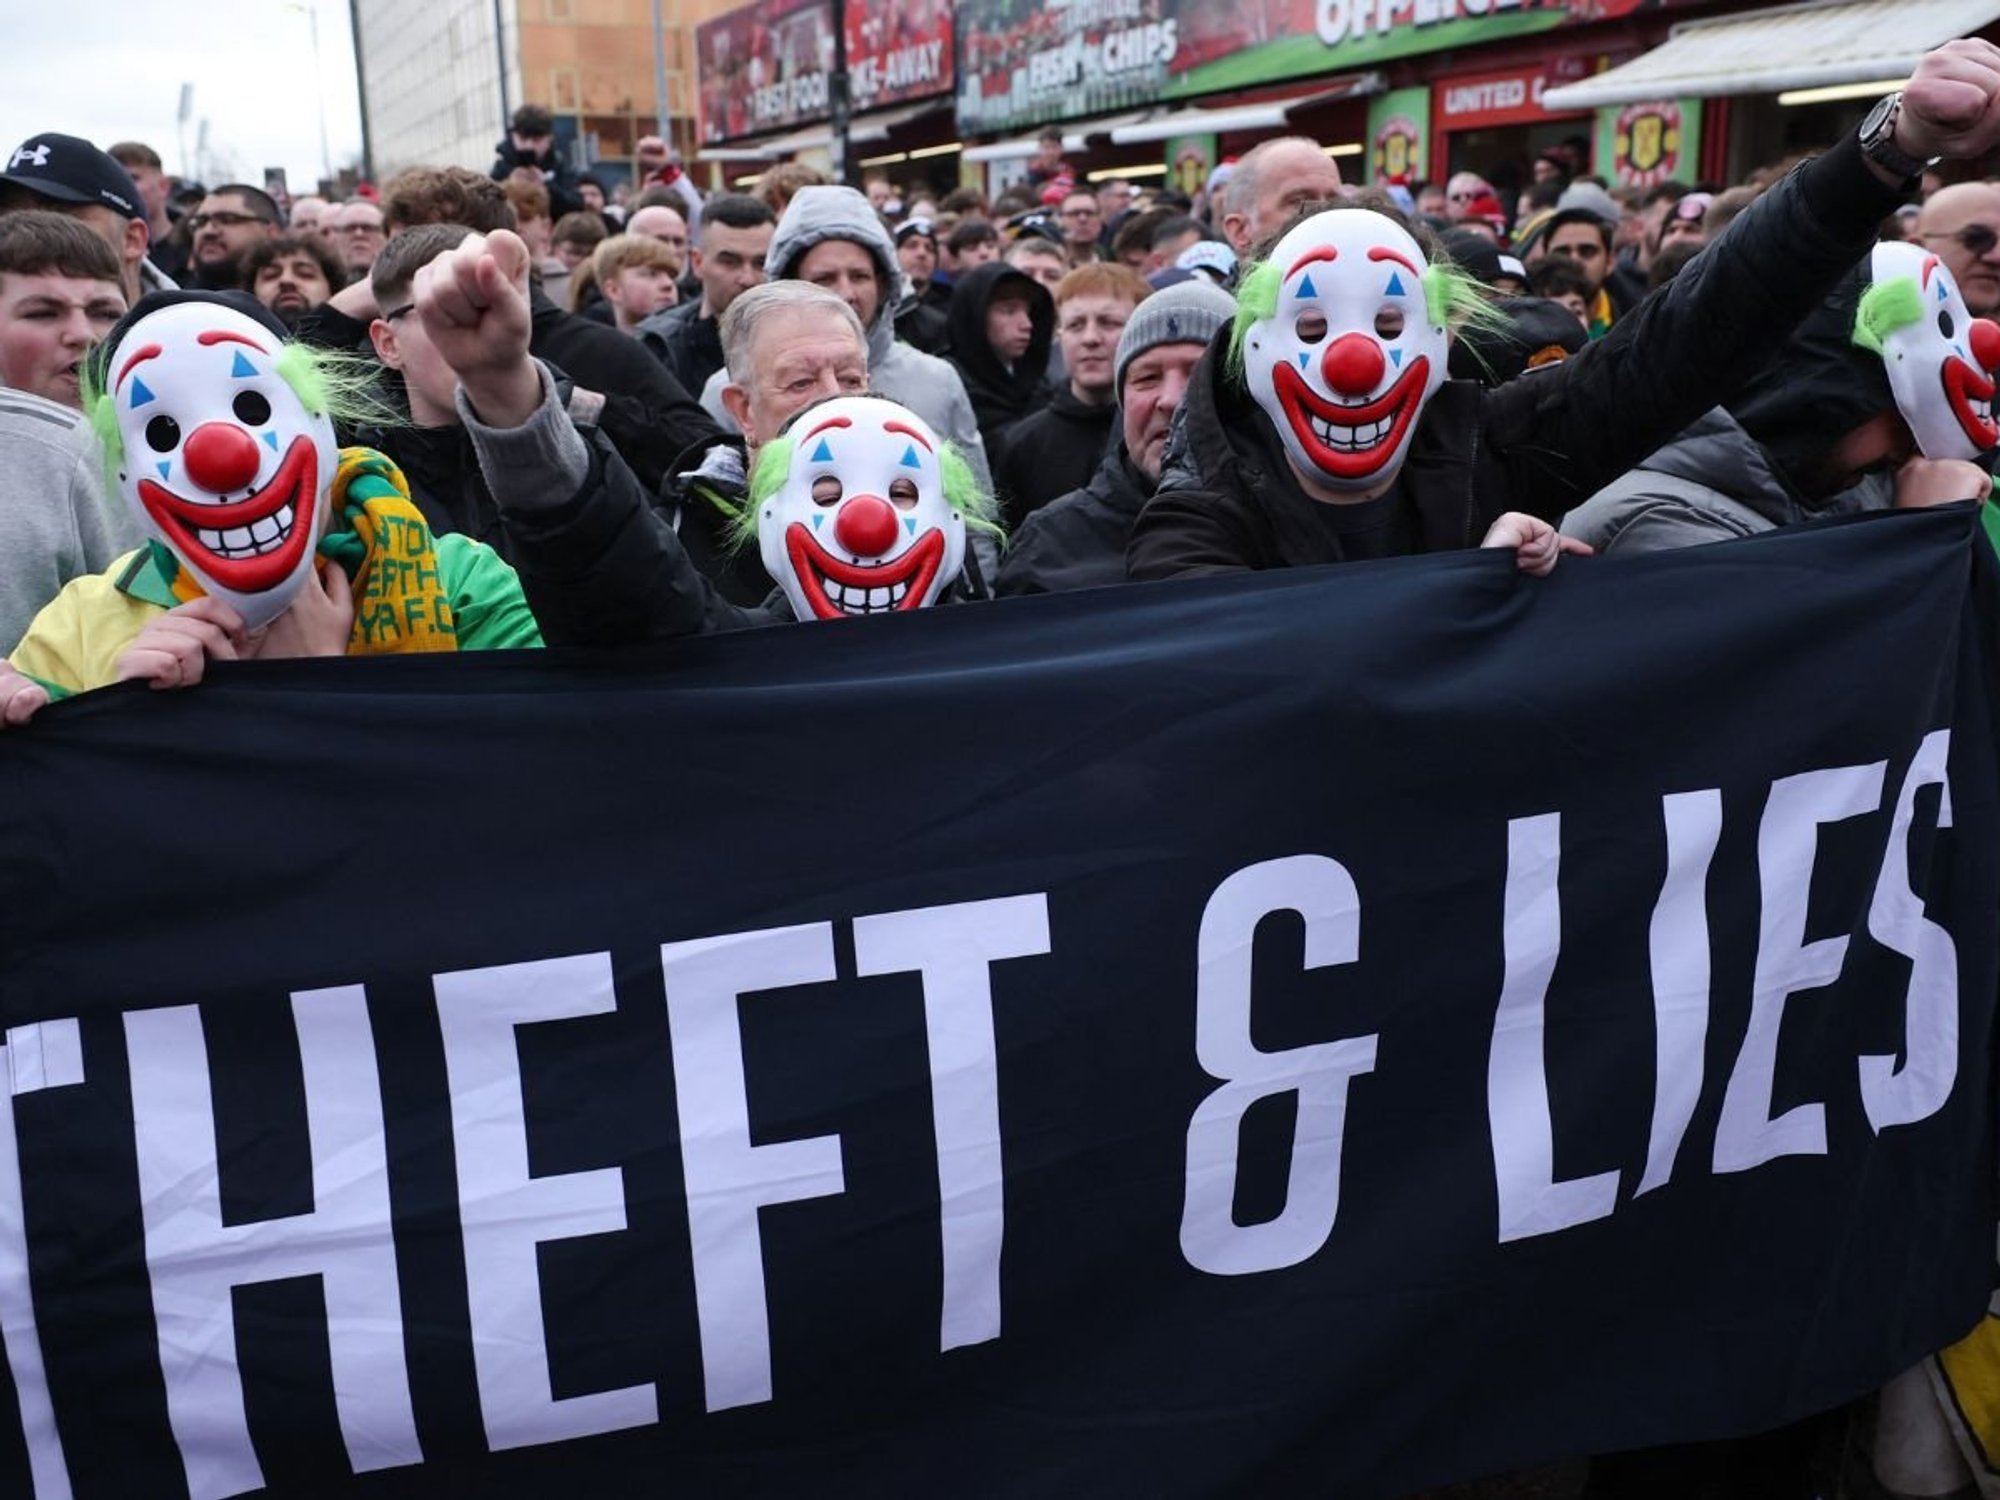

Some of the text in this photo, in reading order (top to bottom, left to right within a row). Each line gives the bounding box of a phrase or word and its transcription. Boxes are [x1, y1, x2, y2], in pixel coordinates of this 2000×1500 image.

[1102, 17, 1178, 75] CHIPS
[1444, 76, 1525, 115] UNITED
[0, 729, 1958, 1500] THEFT & LIES
